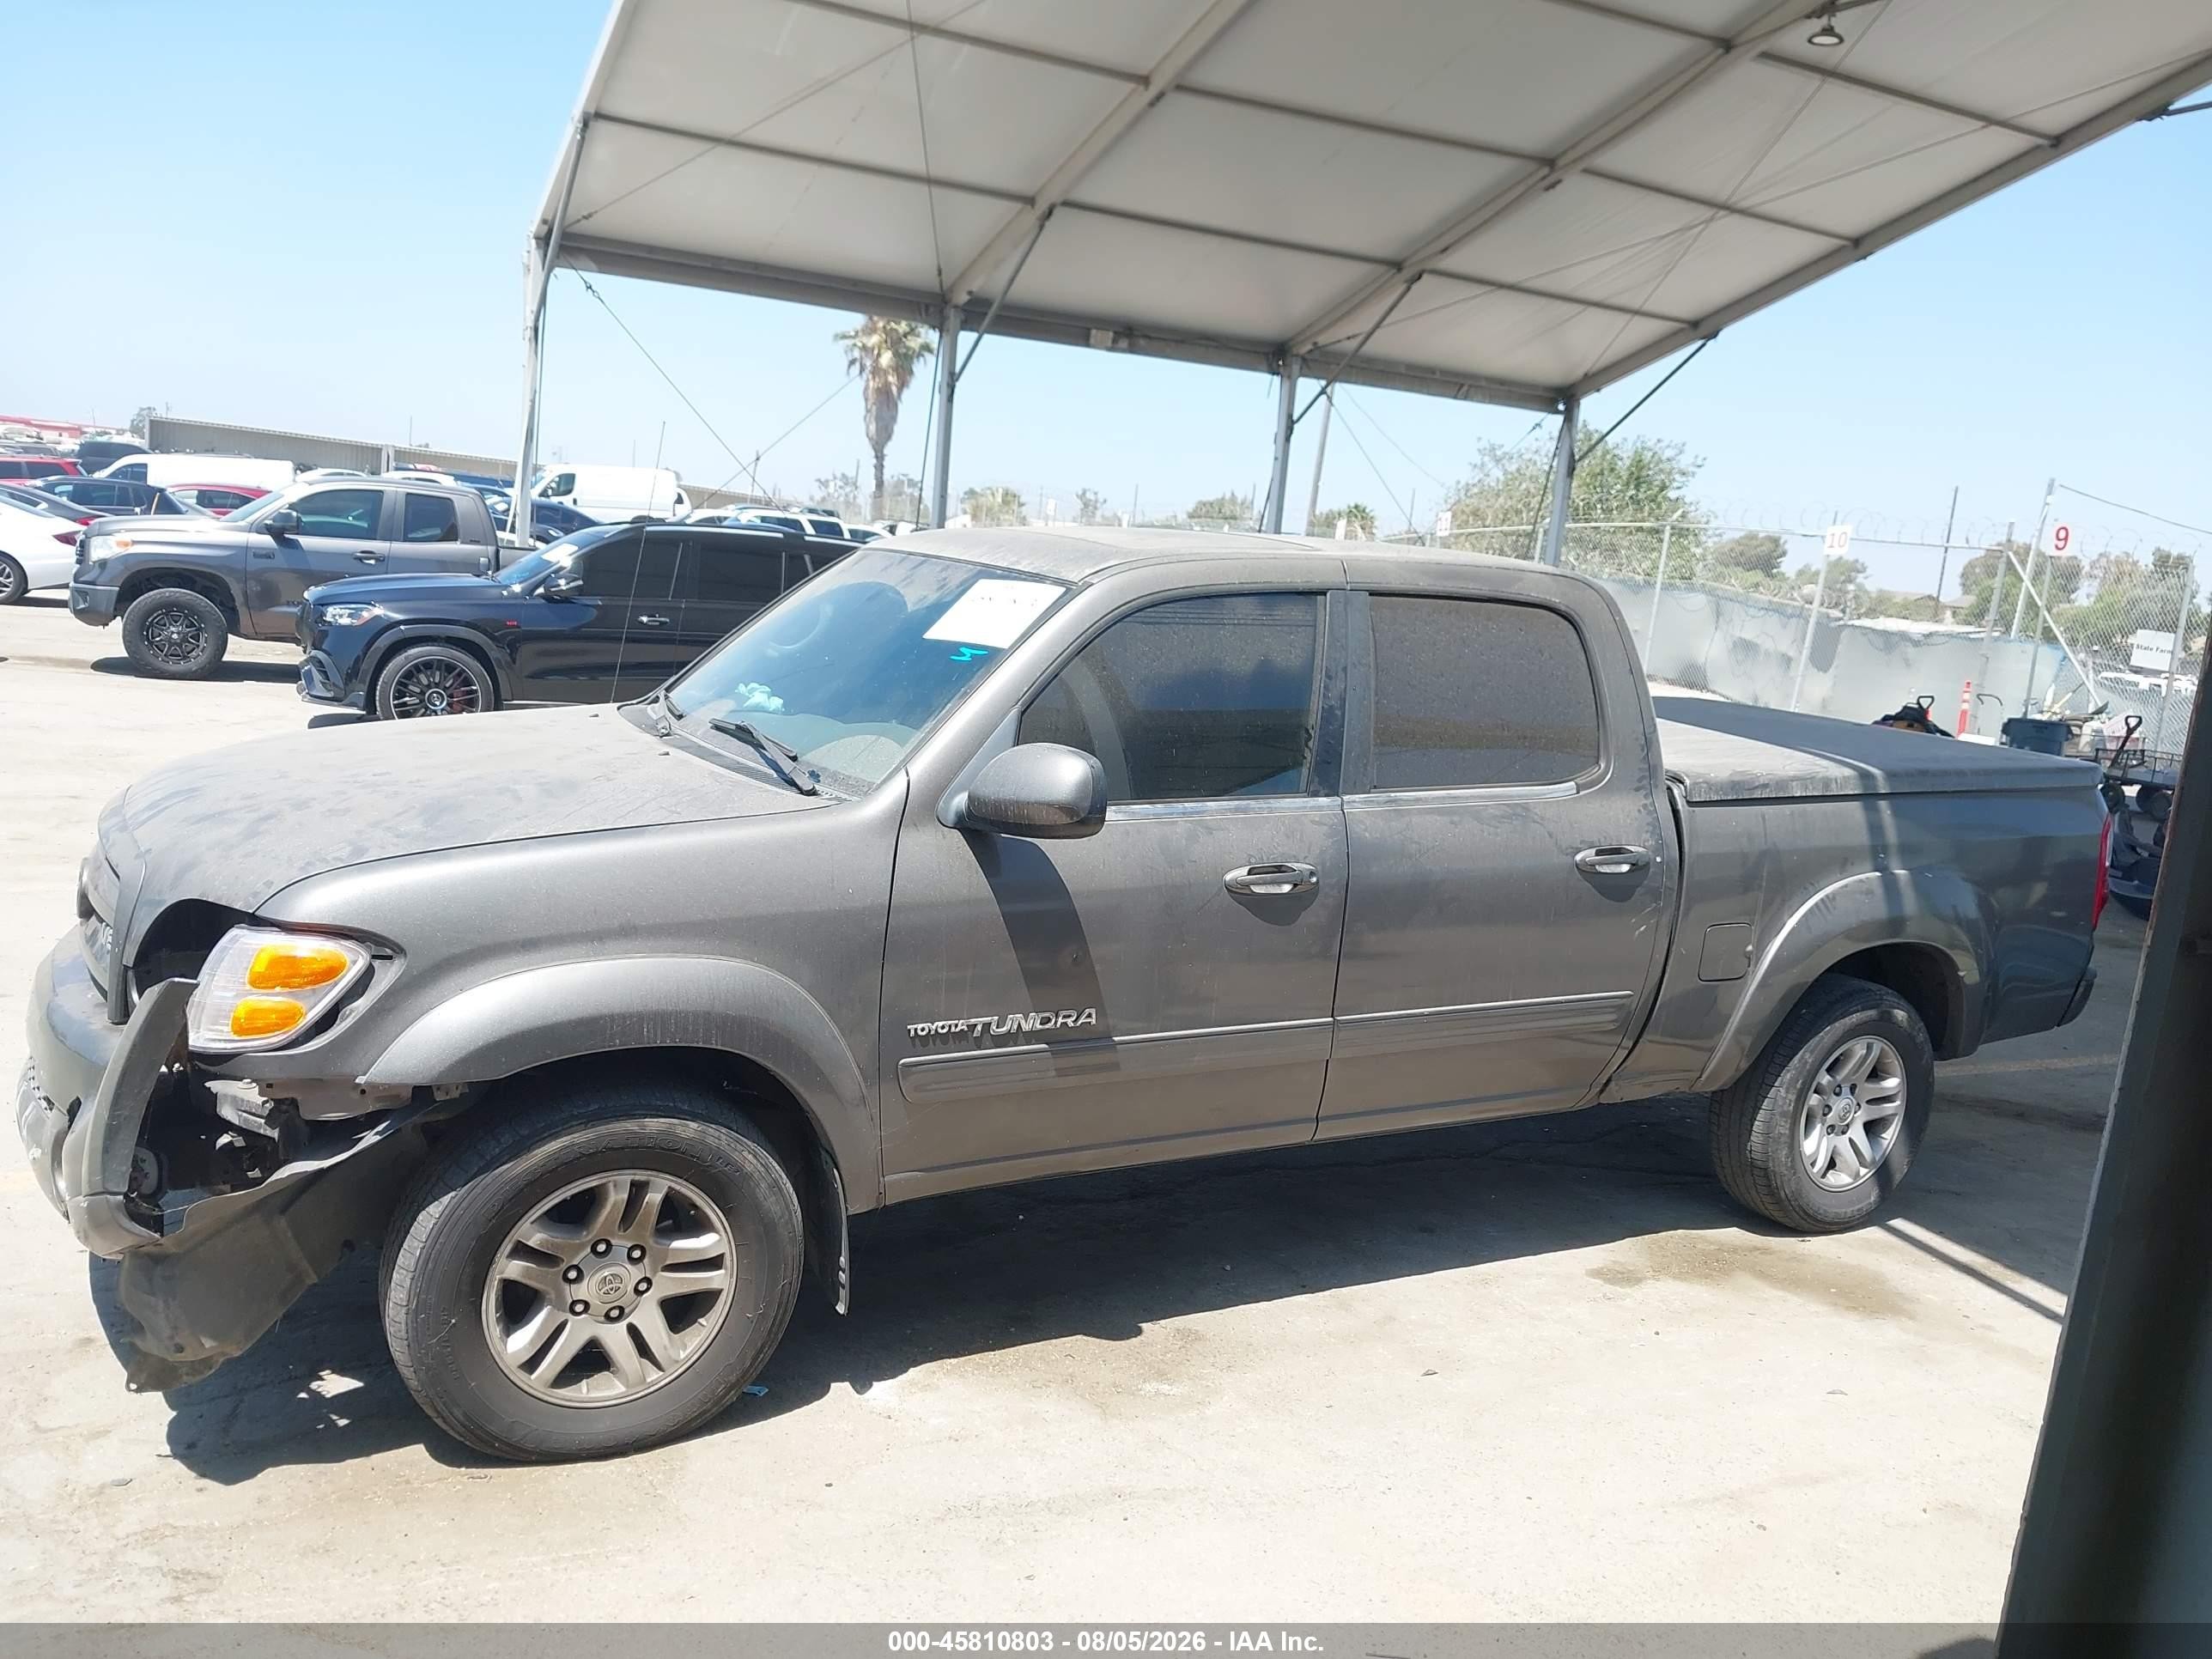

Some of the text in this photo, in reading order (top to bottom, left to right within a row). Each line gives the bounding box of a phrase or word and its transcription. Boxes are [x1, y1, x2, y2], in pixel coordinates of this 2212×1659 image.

[1826, 531, 1848, 549] 10
[2055, 526, 2069, 551] 9
[907, 1008, 1097, 1037] TOYOTA TUNDRA
